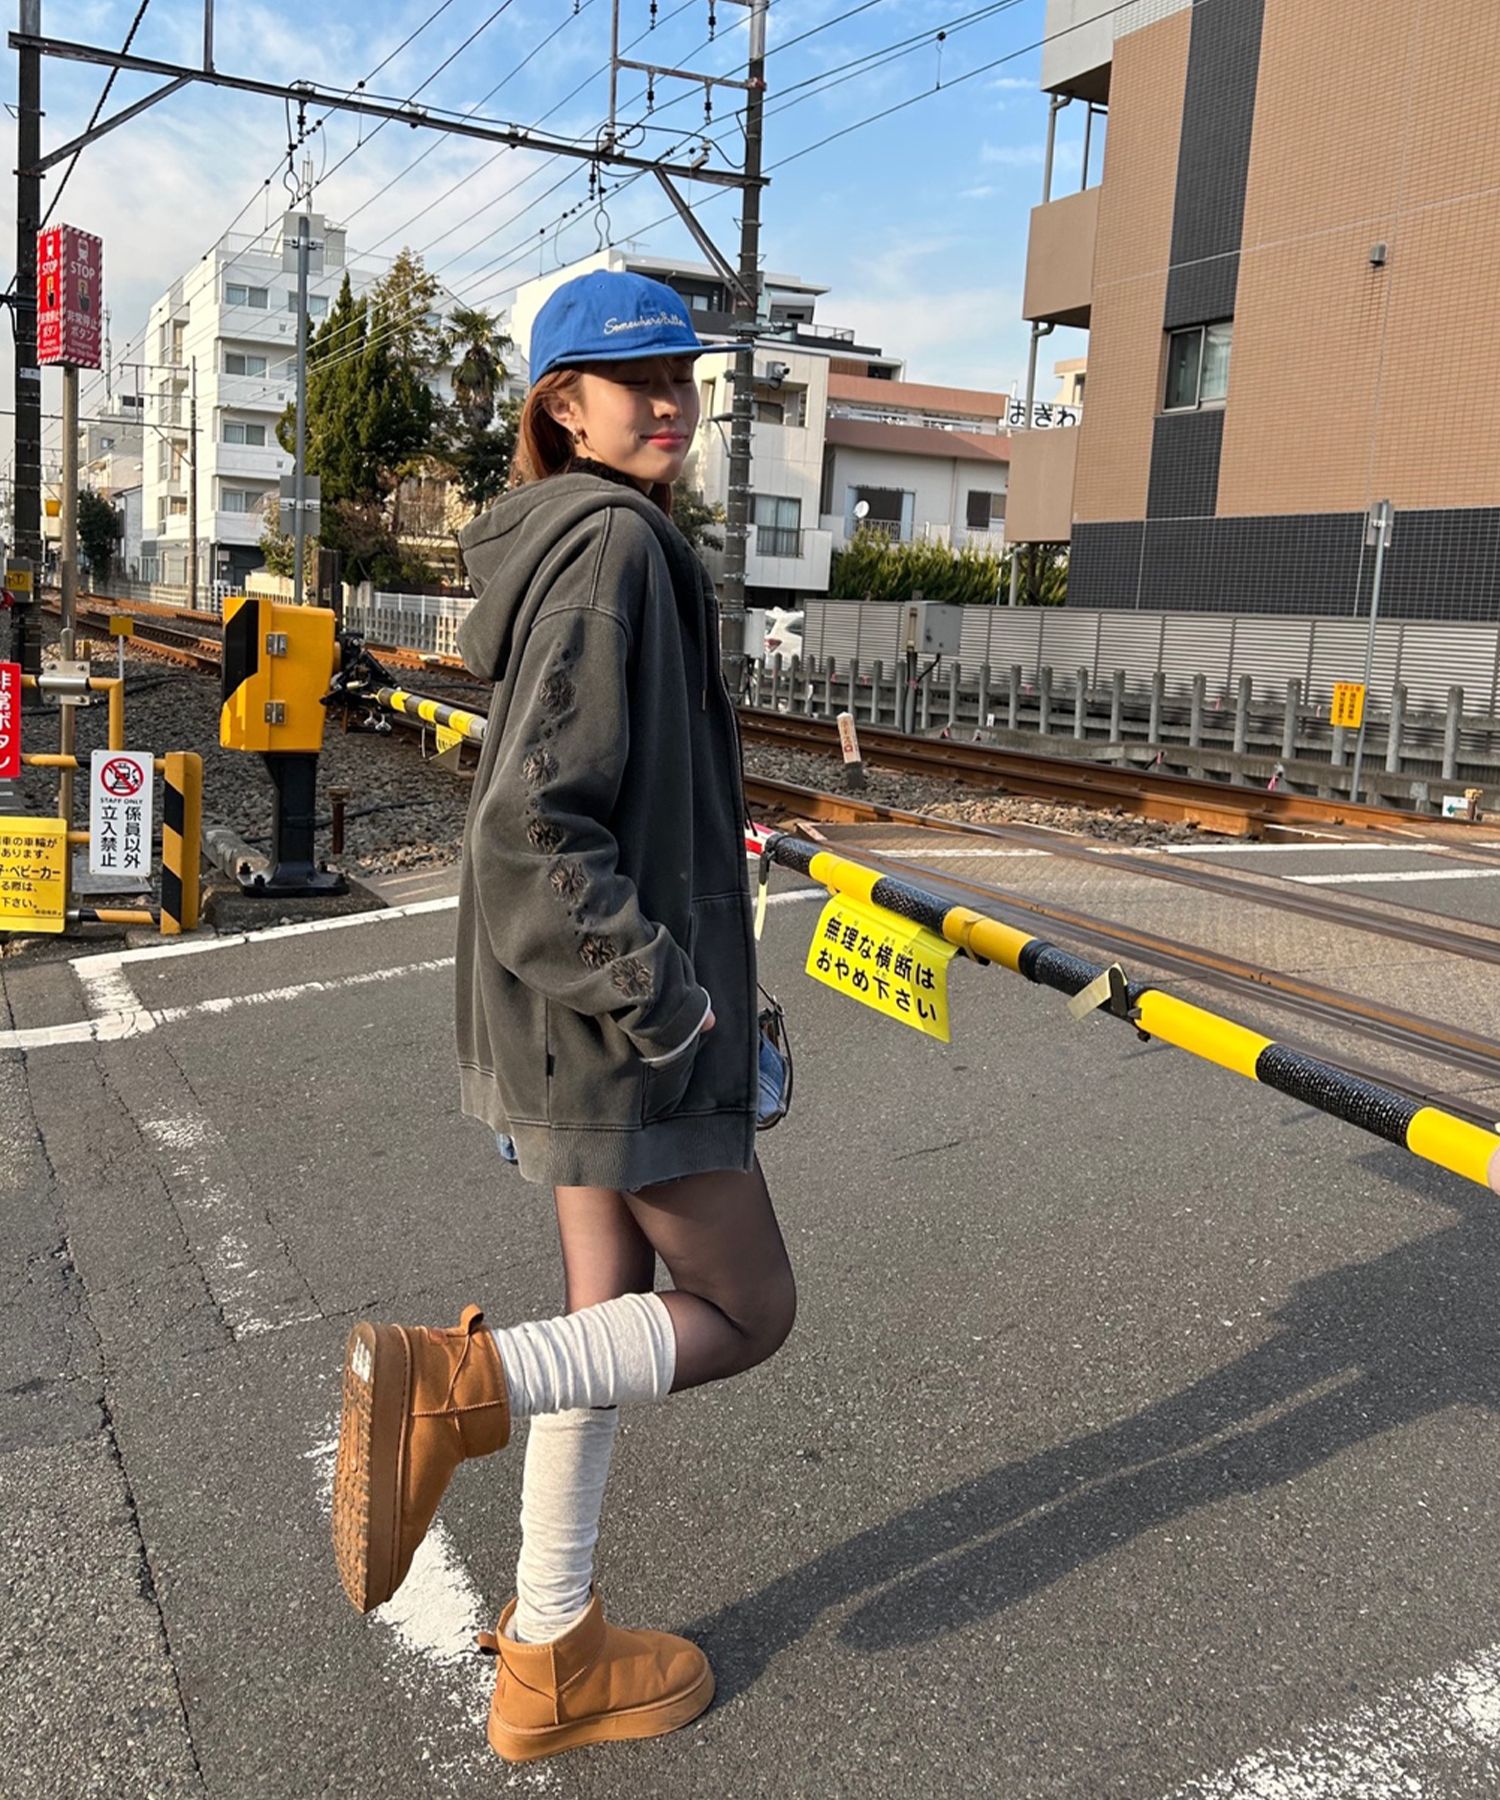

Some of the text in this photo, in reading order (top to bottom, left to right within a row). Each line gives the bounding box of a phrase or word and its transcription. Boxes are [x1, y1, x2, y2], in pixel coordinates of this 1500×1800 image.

[42, 259, 58, 275] STOP
[71, 261, 95, 280] STOP
[101, 805, 118, 867] 立入禁止
[124, 805, 141, 869] 係員以外
[816, 947, 937, 1021] おやめ下さい
[824, 916, 935, 990] 無理な横断は
